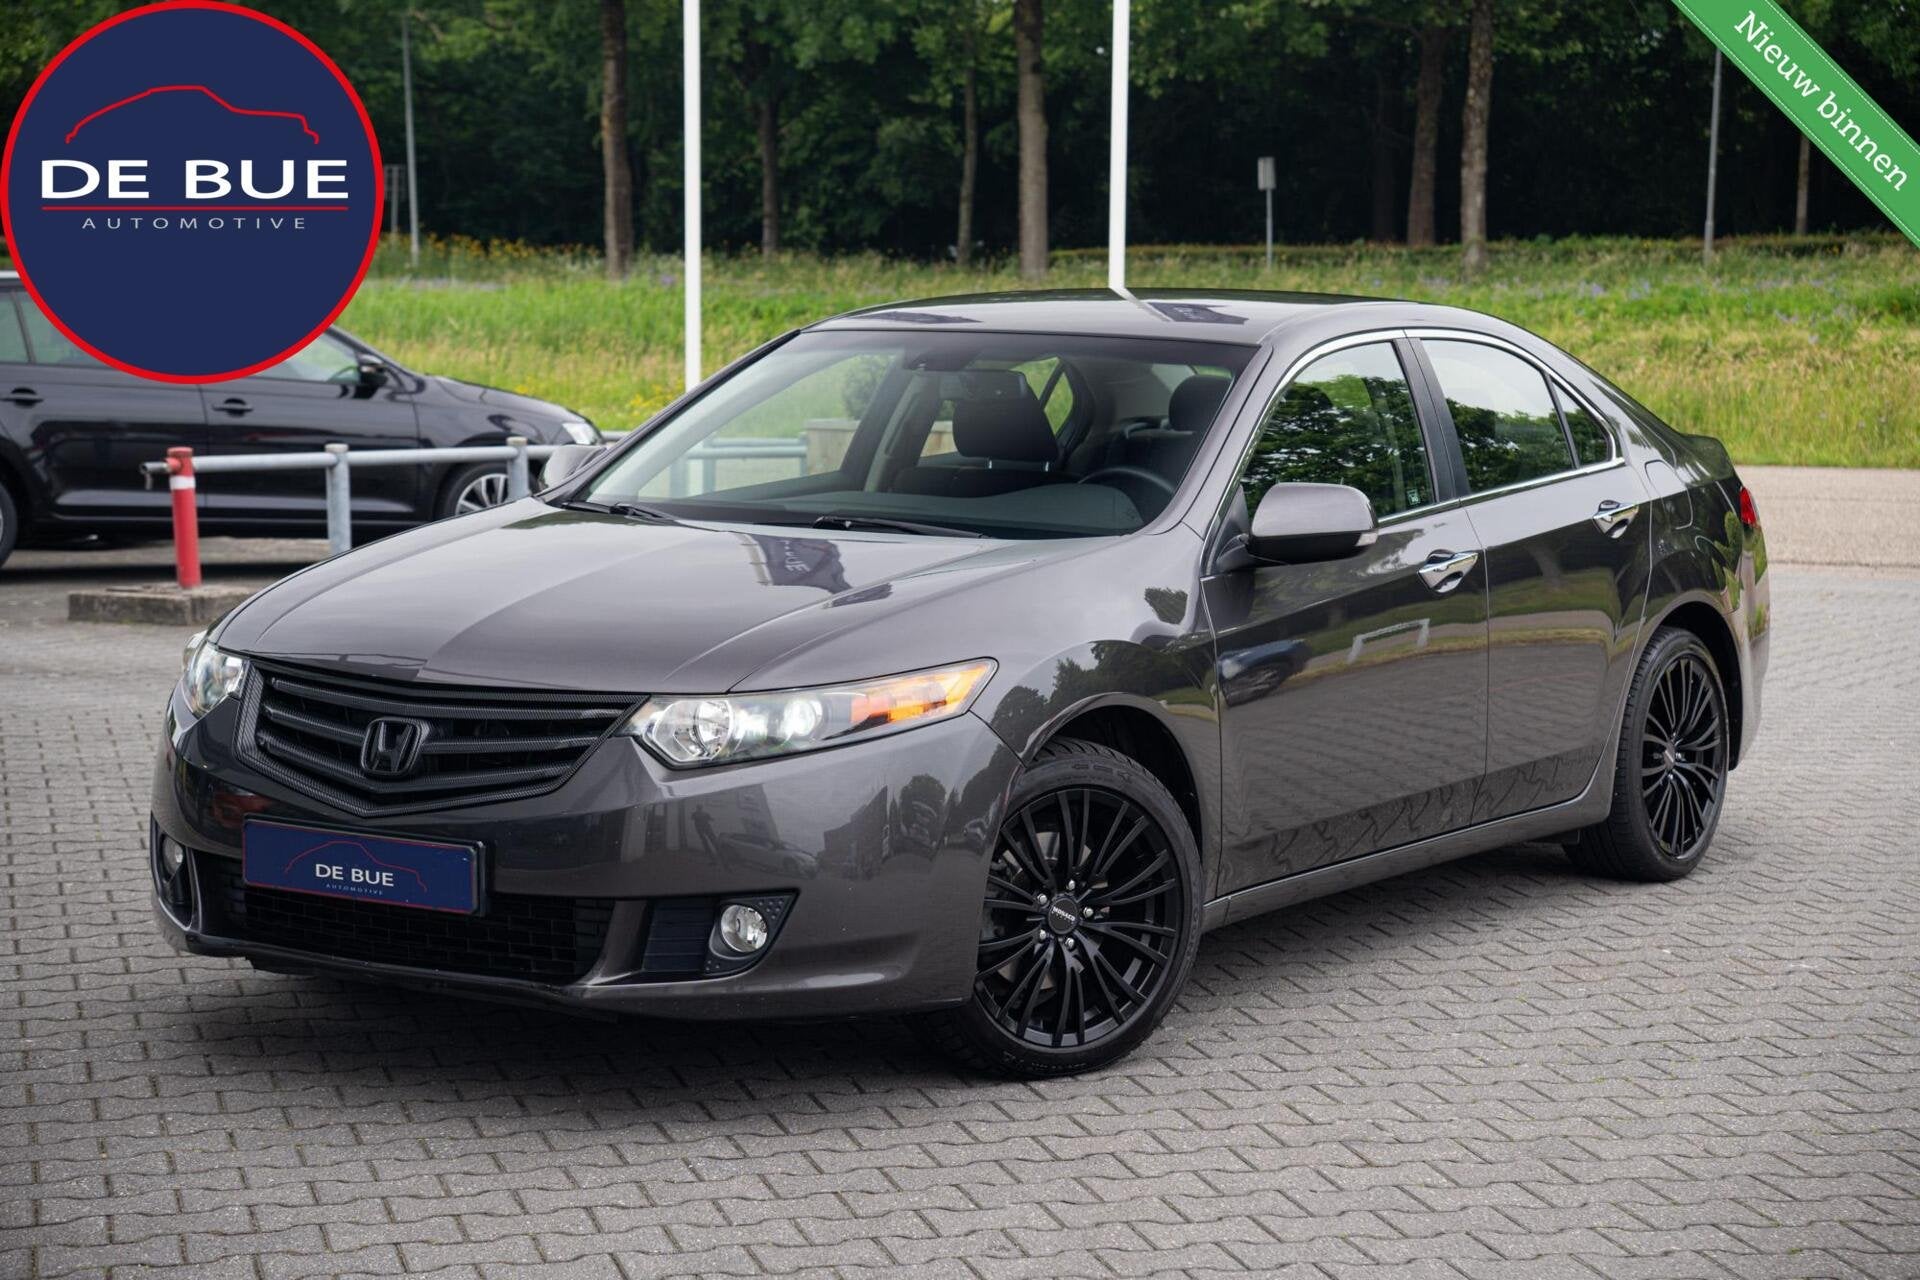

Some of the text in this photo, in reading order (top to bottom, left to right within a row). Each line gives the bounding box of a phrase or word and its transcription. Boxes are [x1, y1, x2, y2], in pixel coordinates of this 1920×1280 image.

[315, 863, 395, 887] DE BUE
[325, 883, 384, 896] AUTOMOTIVE
